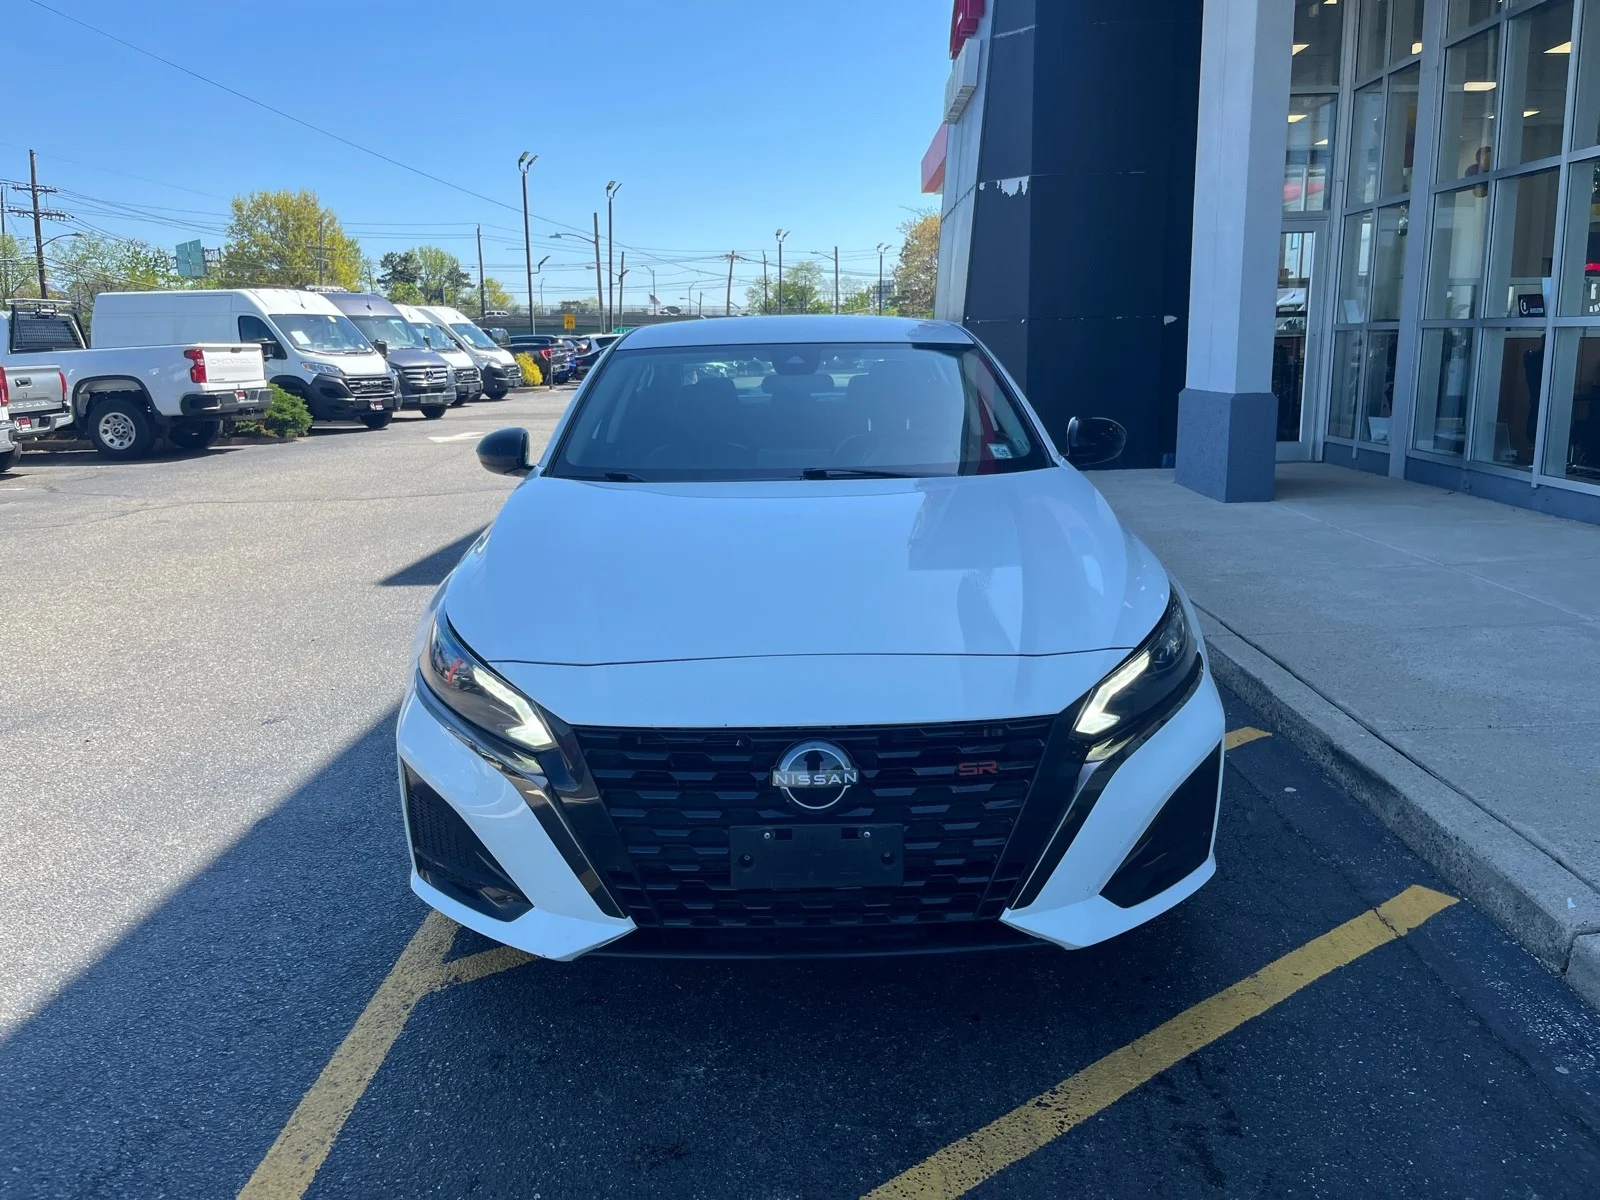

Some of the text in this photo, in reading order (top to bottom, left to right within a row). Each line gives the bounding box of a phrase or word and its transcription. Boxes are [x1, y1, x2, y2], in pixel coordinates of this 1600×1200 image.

[8, 401, 49, 409] ACOMA
[959, 760, 998, 775] SR
[775, 771, 857, 785] NISSAN
